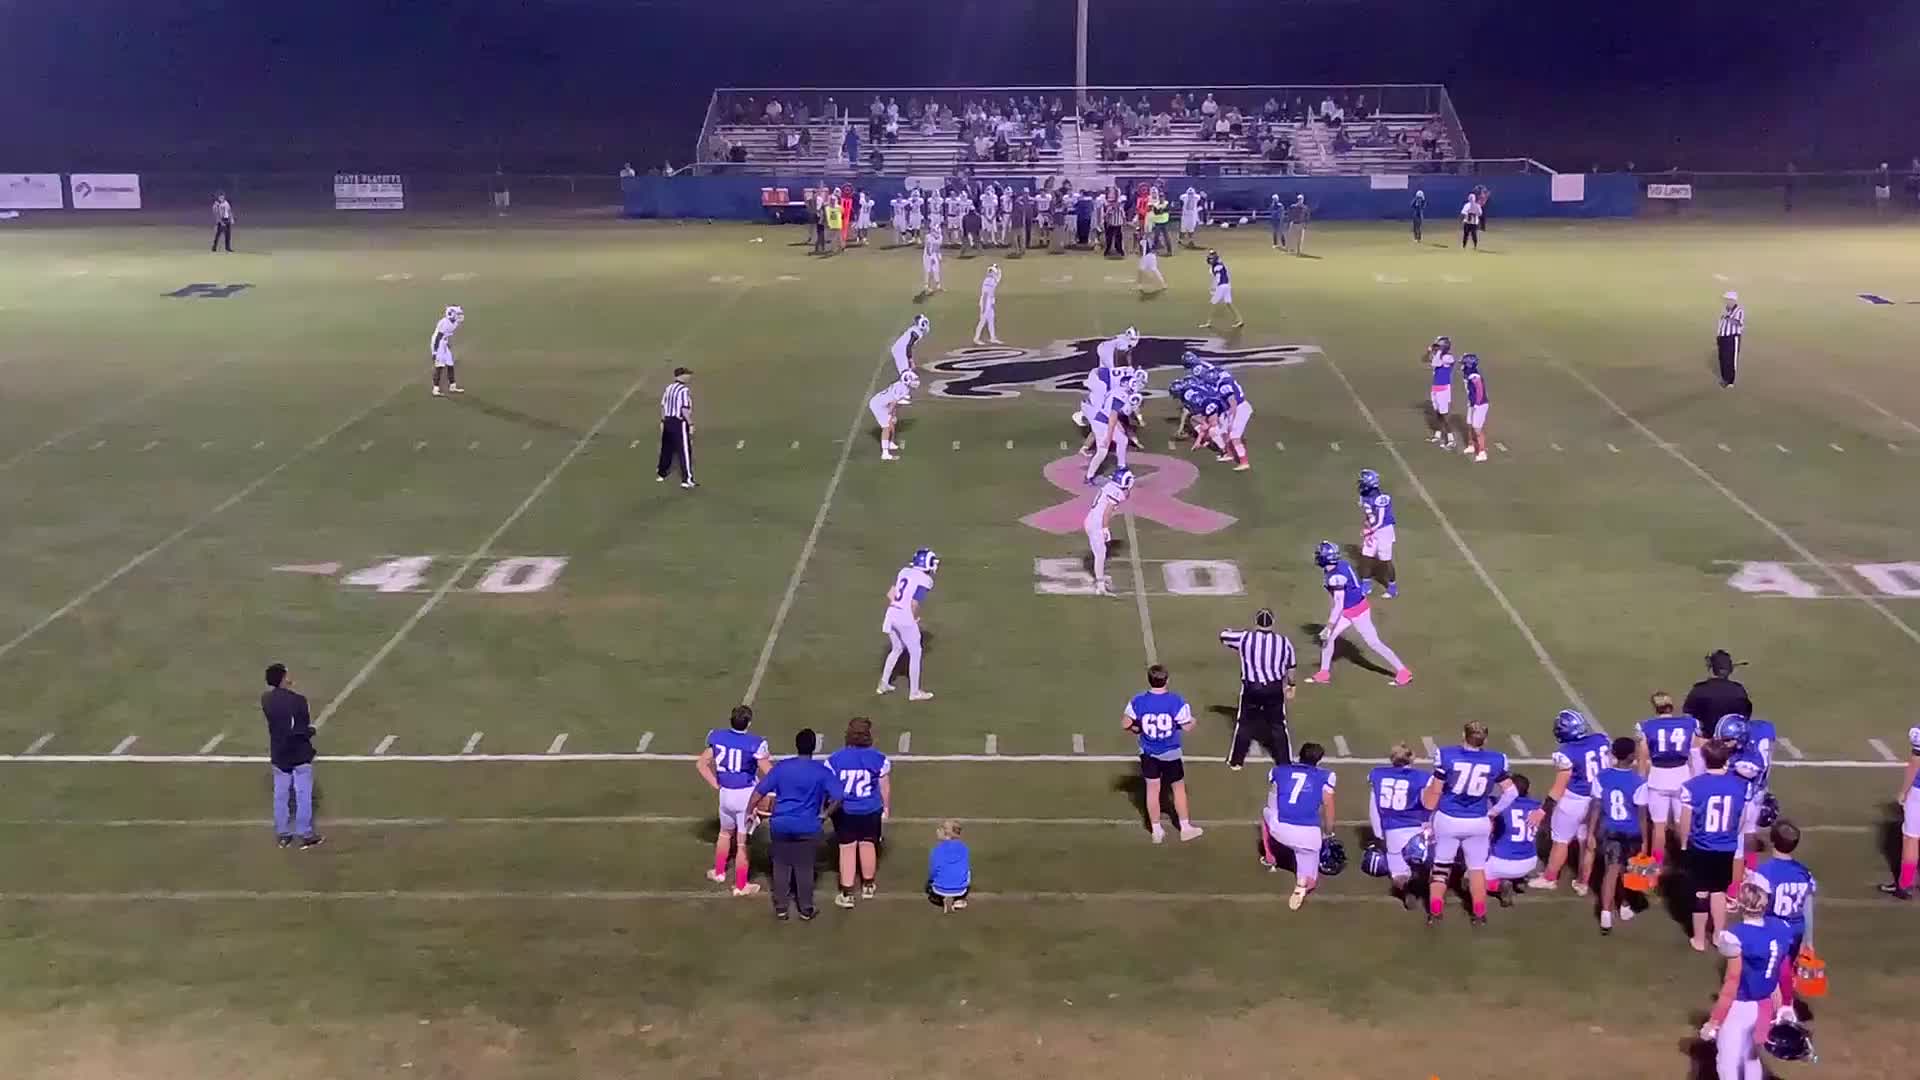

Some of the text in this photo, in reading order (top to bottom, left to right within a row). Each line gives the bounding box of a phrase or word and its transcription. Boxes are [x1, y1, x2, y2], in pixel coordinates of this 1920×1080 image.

[894, 577, 909, 602] 3
[1142, 713, 1173, 739] 69
[1657, 728, 1686, 752] 14
[715, 744, 742, 773] 20
[840, 769, 872, 797] 72
[1288, 772, 1307, 804] 7
[1379, 777, 1410, 811] 58
[1452, 762, 1490, 796] 76
[1610, 790, 1628, 820] 8
[1705, 795, 1732, 832] 61
[1774, 882, 1808, 916] 67
[1765, 939, 1778, 979] 1
